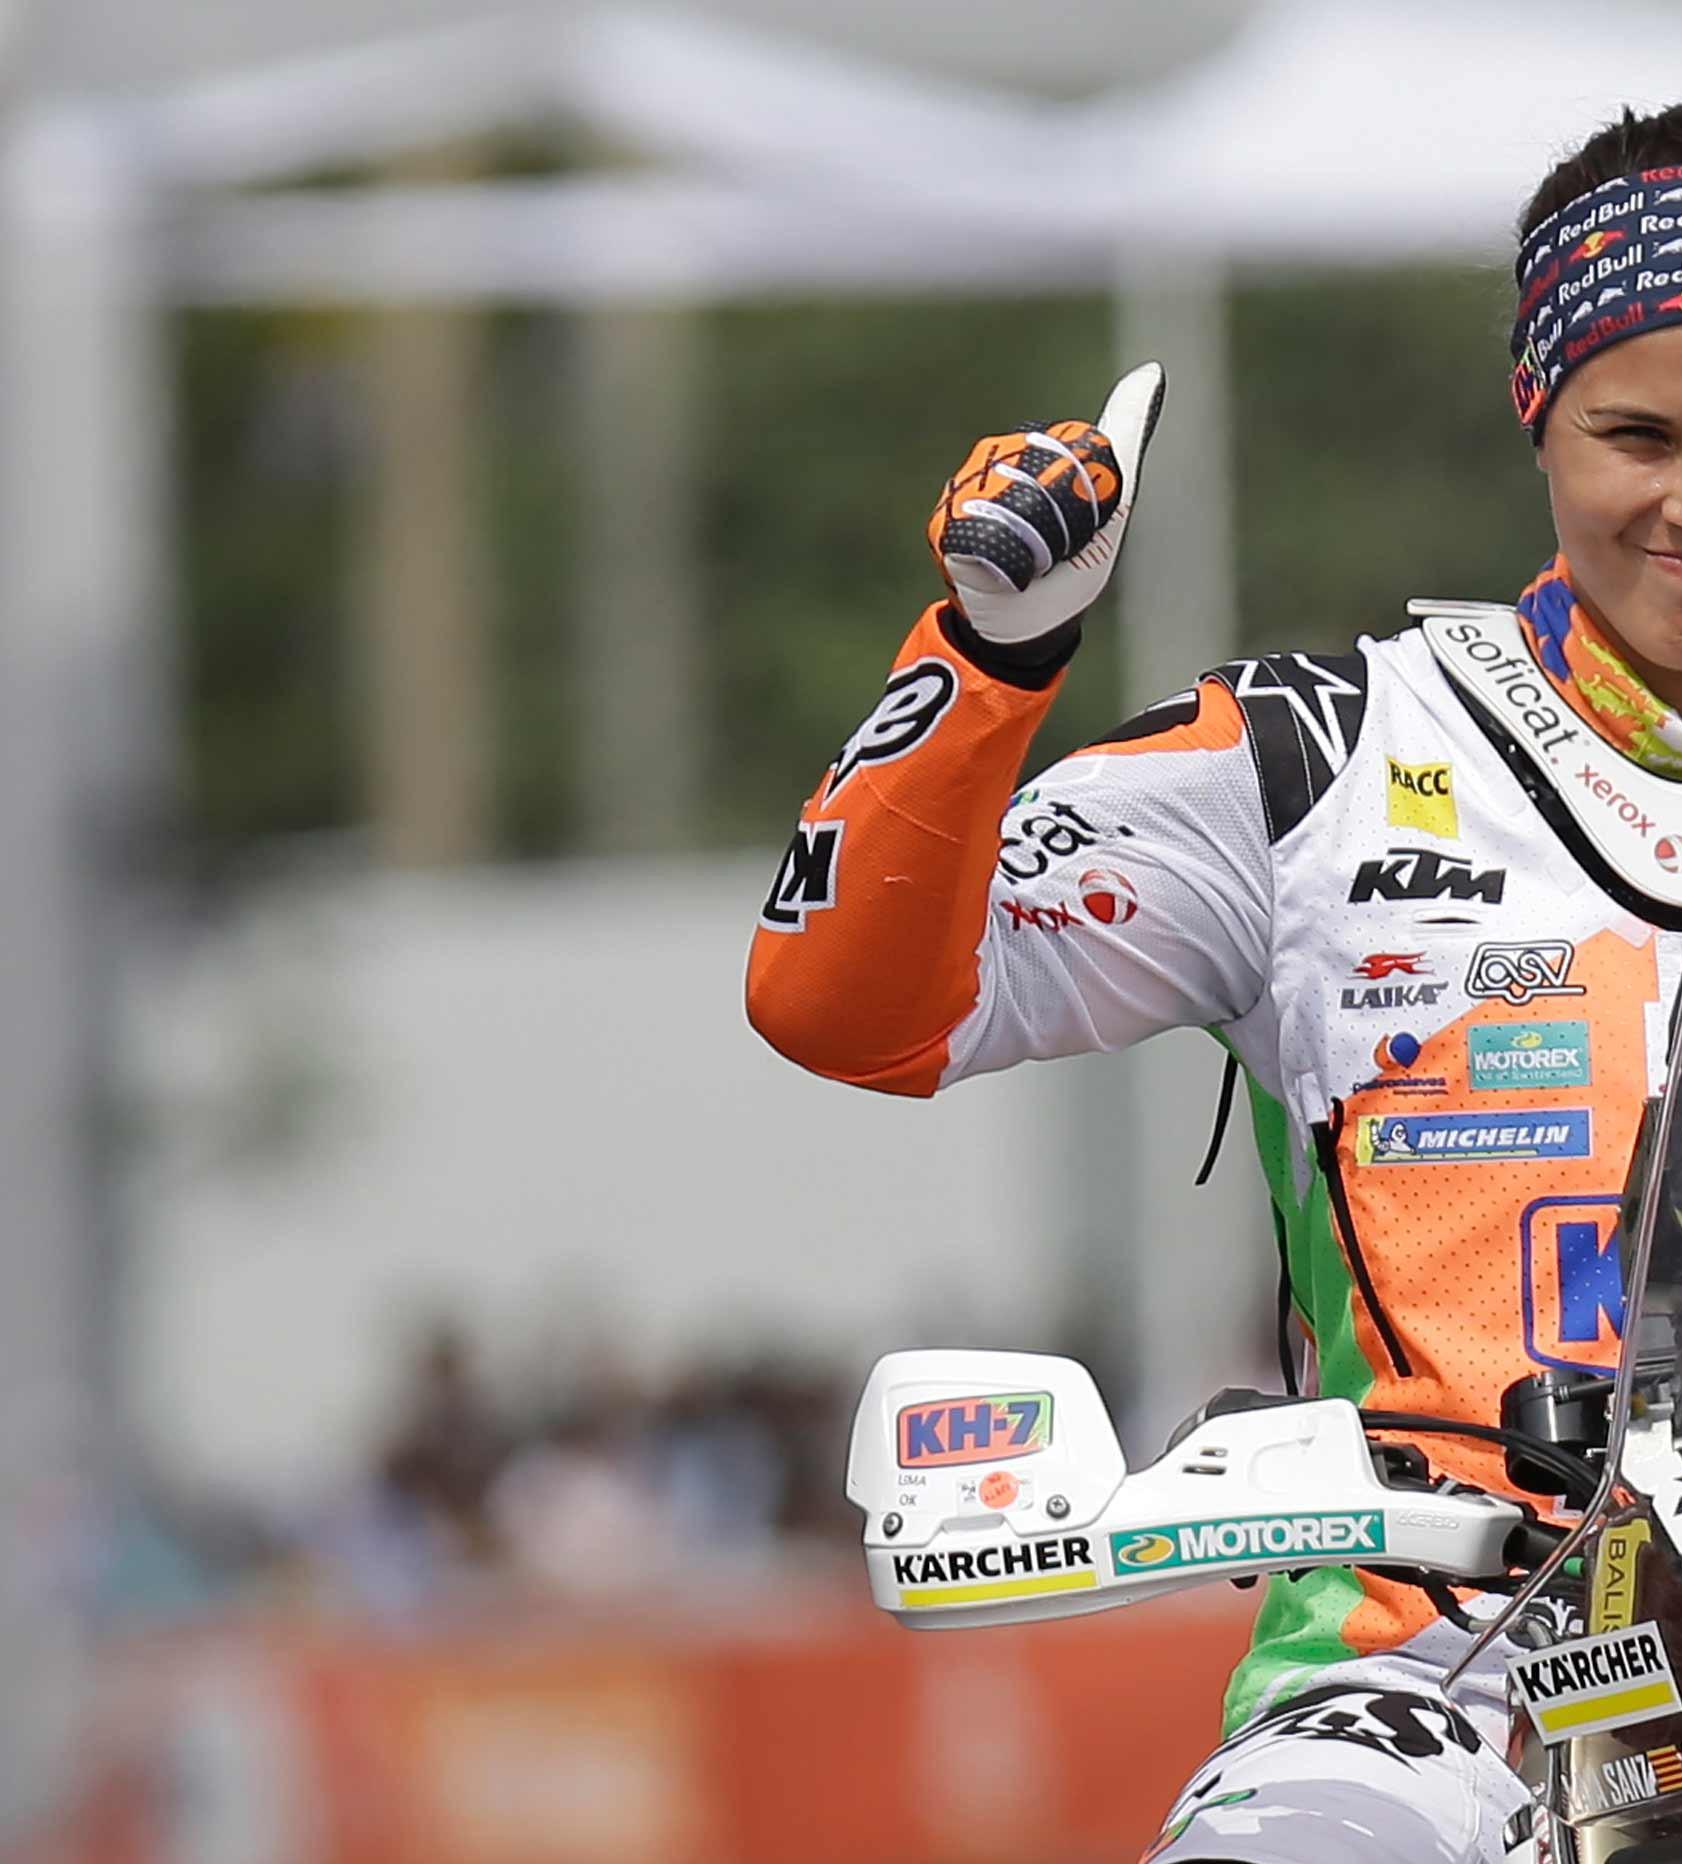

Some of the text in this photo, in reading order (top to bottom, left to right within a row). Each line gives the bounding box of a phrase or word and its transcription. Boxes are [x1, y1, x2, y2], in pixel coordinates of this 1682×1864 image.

[1558, 192, 1644, 247] Red Bull
[1558, 264, 1595, 306] Red
[1597, 243, 1642, 280] Bull
[1599, 302, 1645, 338] Bull
[1389, 760, 1450, 797] RACC
[1575, 762, 1657, 838] xerox
[1347, 848, 1507, 905] KTM
[1340, 982, 1449, 1010] LAIKA
[1474, 1047, 1580, 1071] MOTOREX
[1417, 1125, 1571, 1149] MICHELIN
[906, 1400, 1041, 1460] KH-7
[894, 1535, 1093, 1585] KÄRCHER
[1179, 1515, 1377, 1560] MOTOREX
[1516, 1634, 1665, 1703] KÄRCHER
[1602, 1754, 1657, 1807] SANZ
